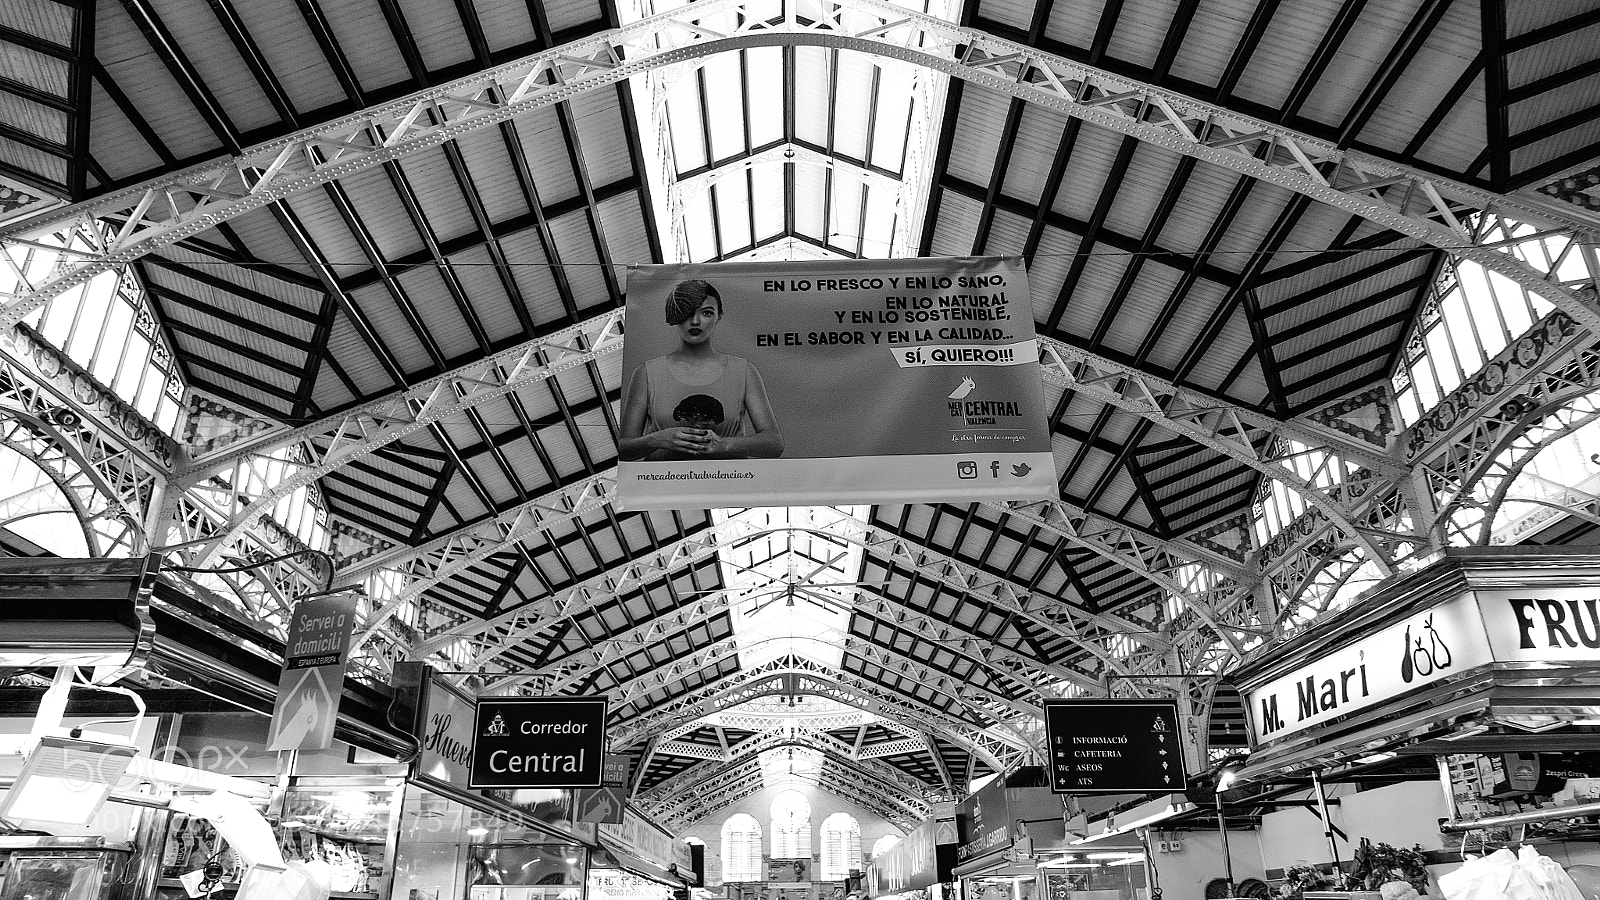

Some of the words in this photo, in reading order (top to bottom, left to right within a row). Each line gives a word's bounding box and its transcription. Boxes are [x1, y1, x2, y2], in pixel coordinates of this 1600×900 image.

[763, 280, 785, 292] EN
[790, 280, 812, 291] LO
[816, 278, 884, 291] FRESCO
[888, 277, 900, 289] Y
[905, 277, 928, 289] EN
[931, 276, 952, 289] LO
[957, 275, 1007, 289] SANO,
[885, 297, 908, 310] EN
[912, 297, 934, 309] LO
[938, 292, 1009, 308] NATURAL
[834, 311, 847, 323] Y
[851, 311, 874, 324] EN
[878, 311, 900, 323] LO
[904, 307, 1011, 323] SOSTENIBLE,
[756, 334, 779, 347] EN
[784, 333, 803, 346] EL
[807, 331, 866, 345] SABOR
[870, 332, 883, 344] Y
[887, 331, 910, 343] EN
[915, 329, 934, 342] LA
[938, 327, 1014, 341] CALIDAD...
[904, 346, 927, 365] SÍ,
[930, 348, 1014, 363] QUIERO!!!
[965, 401, 1023, 416] CENTRAL
[966, 417, 996, 425] VALENCIA
[637, 470, 755, 481] mercadocentralvalencia.es
[298, 610, 336, 633] Servei
[337, 614, 346, 628] a
[293, 631, 342, 656] domicili
[1262, 694, 1285, 736] M.
[520, 720, 588, 735] Corredor
[1072, 735, 1128, 744] INFORMACIÓ
[489, 748, 585, 773] Central
[1074, 750, 1122, 758] CAFETERIA
